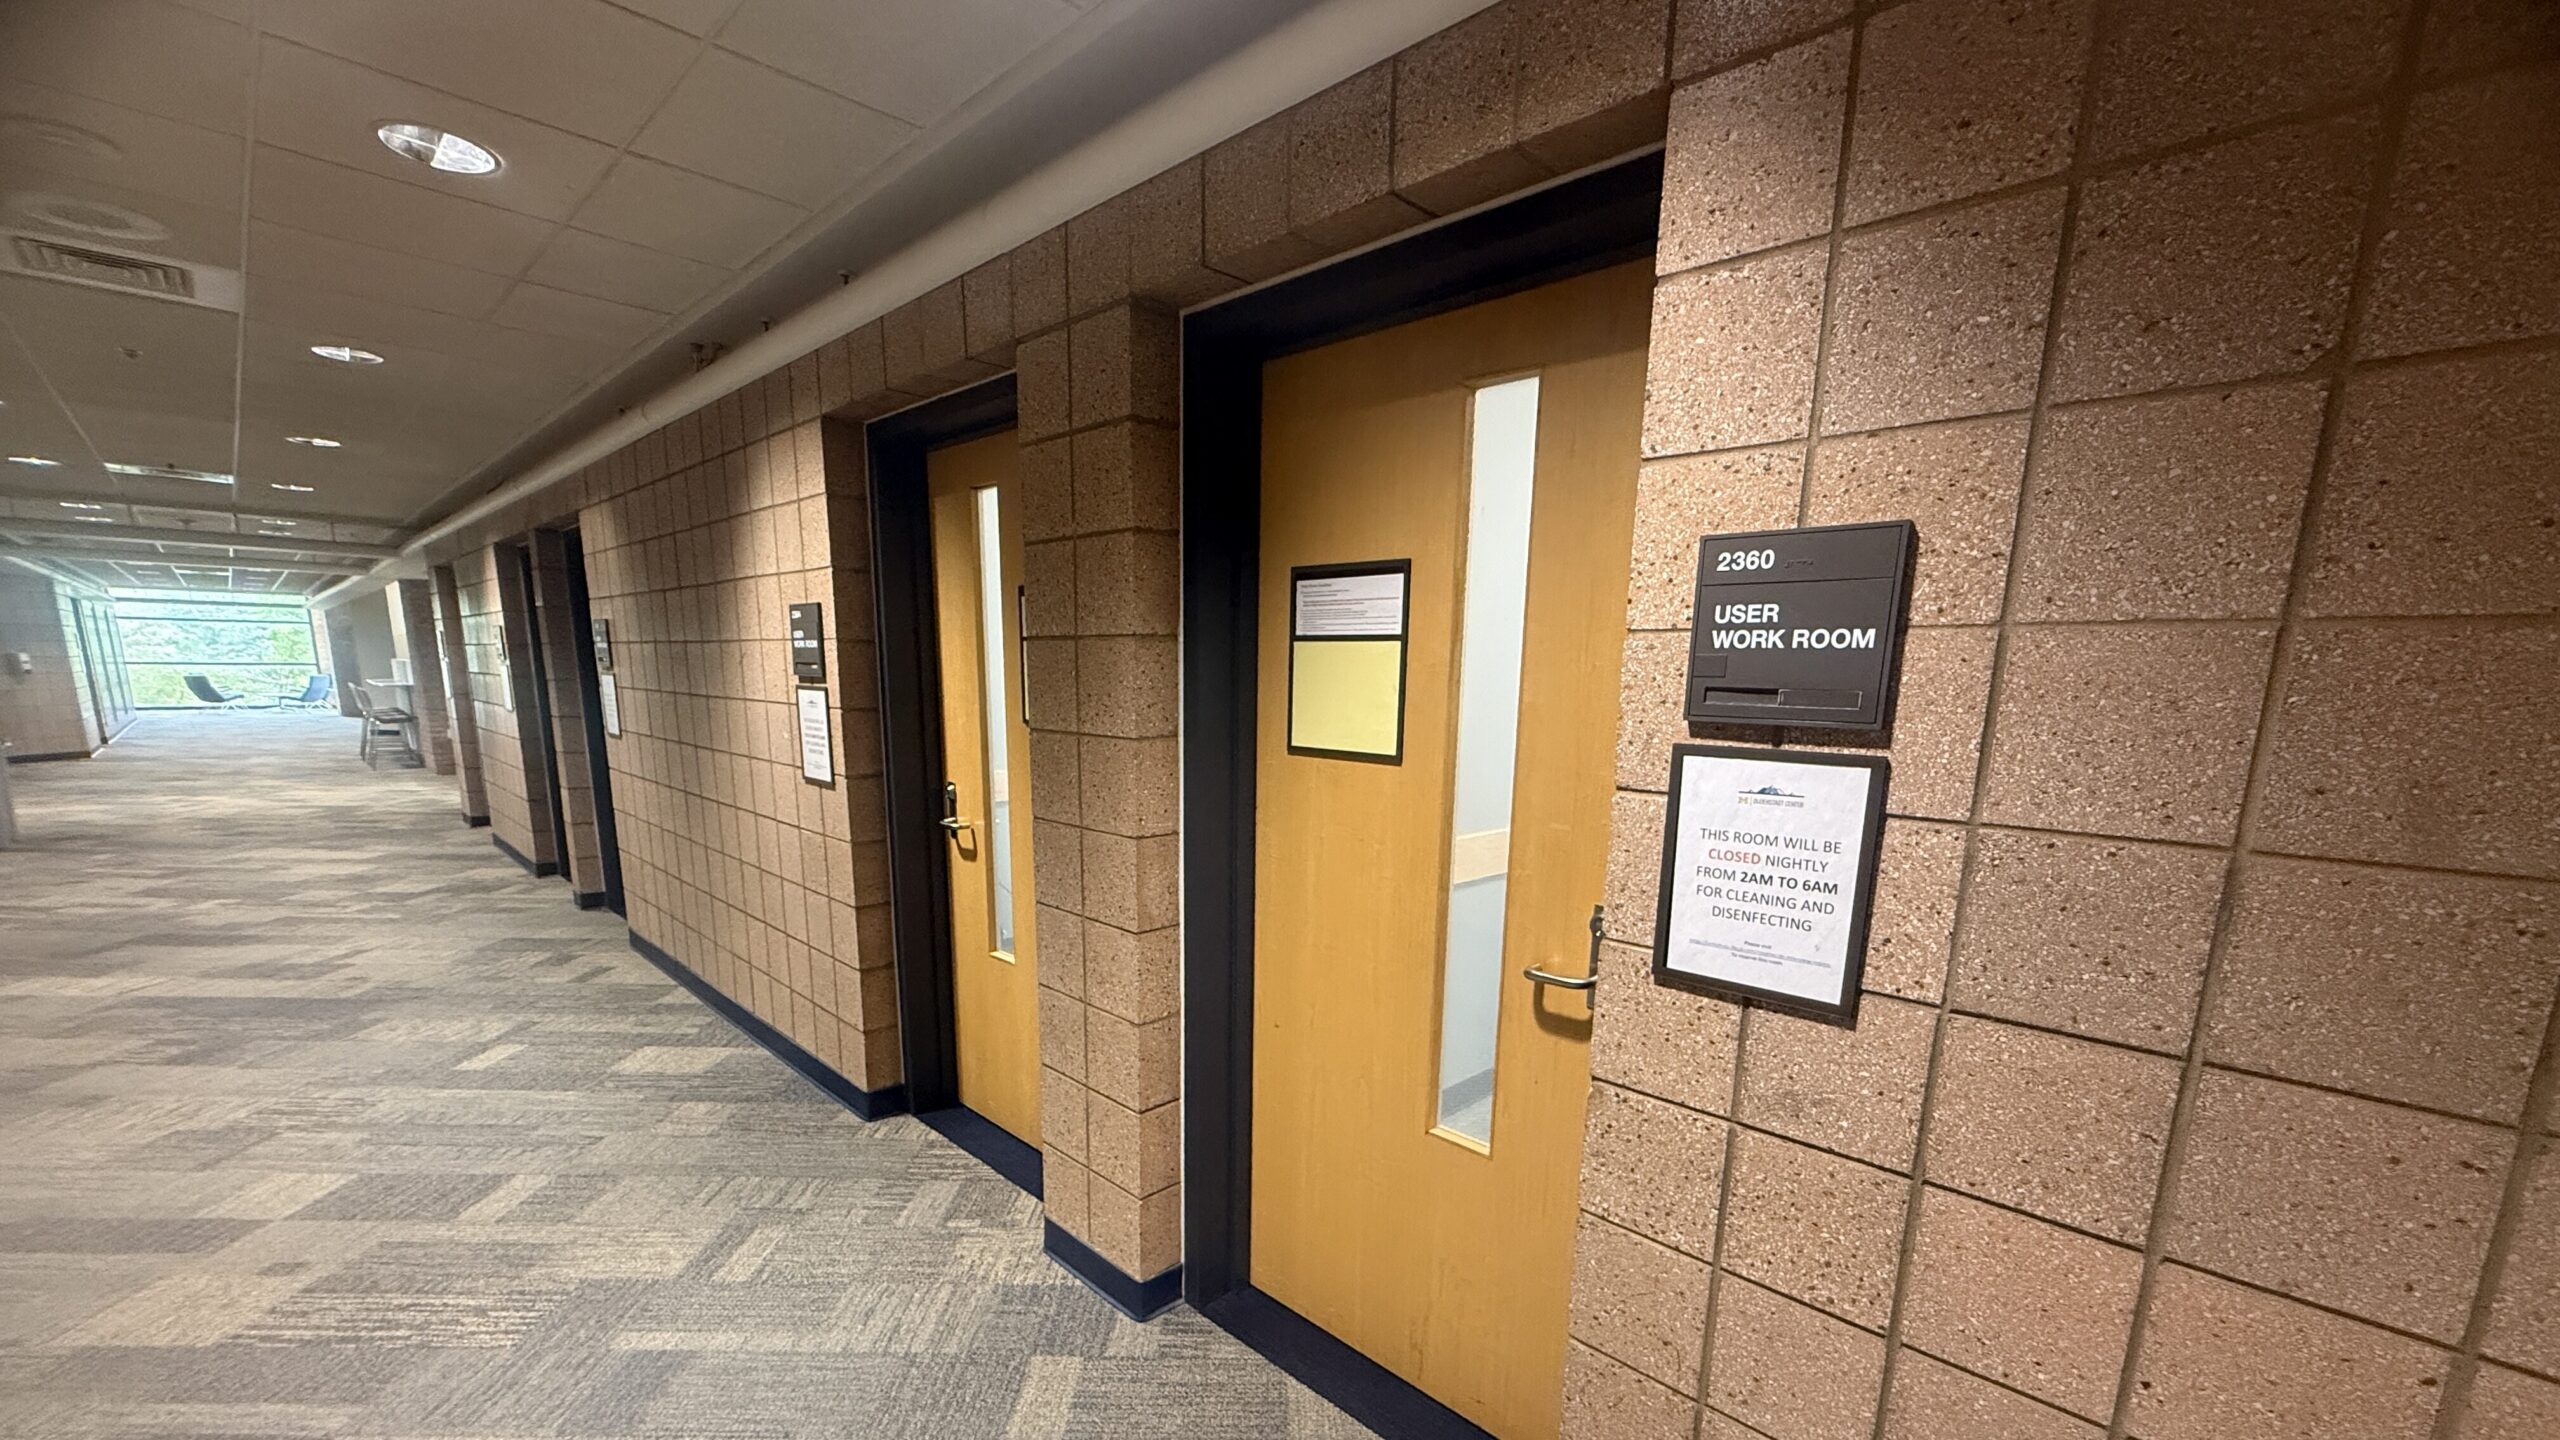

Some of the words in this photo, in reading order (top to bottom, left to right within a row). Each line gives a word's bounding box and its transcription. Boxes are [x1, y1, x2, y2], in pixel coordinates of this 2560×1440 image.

[1716, 549, 1775, 572] 2360
[1714, 604, 1780, 624] USER
[1712, 629, 1785, 649] WORK
[1791, 628, 1876, 649] ROOM
[1700, 828, 1730, 842] THIS
[1733, 831, 1779, 848] ROOM
[1783, 836, 1819, 852] WILL
[1823, 840, 1842, 854] BE
[1708, 848, 1761, 865] CLOSED
[1765, 855, 1829, 873] NIGHTLY
[1696, 865, 1736, 881] FROM
[1740, 871, 1774, 886] 2AM
[1777, 876, 1798, 890] TO
[1802, 879, 1839, 895] 6AM
[1696, 884, 1723, 899] FOR
[1726, 888, 1798, 910] CLEANING
[1800, 900, 1835, 915] AND
[1711, 905, 1813, 932] DISENFECTING
